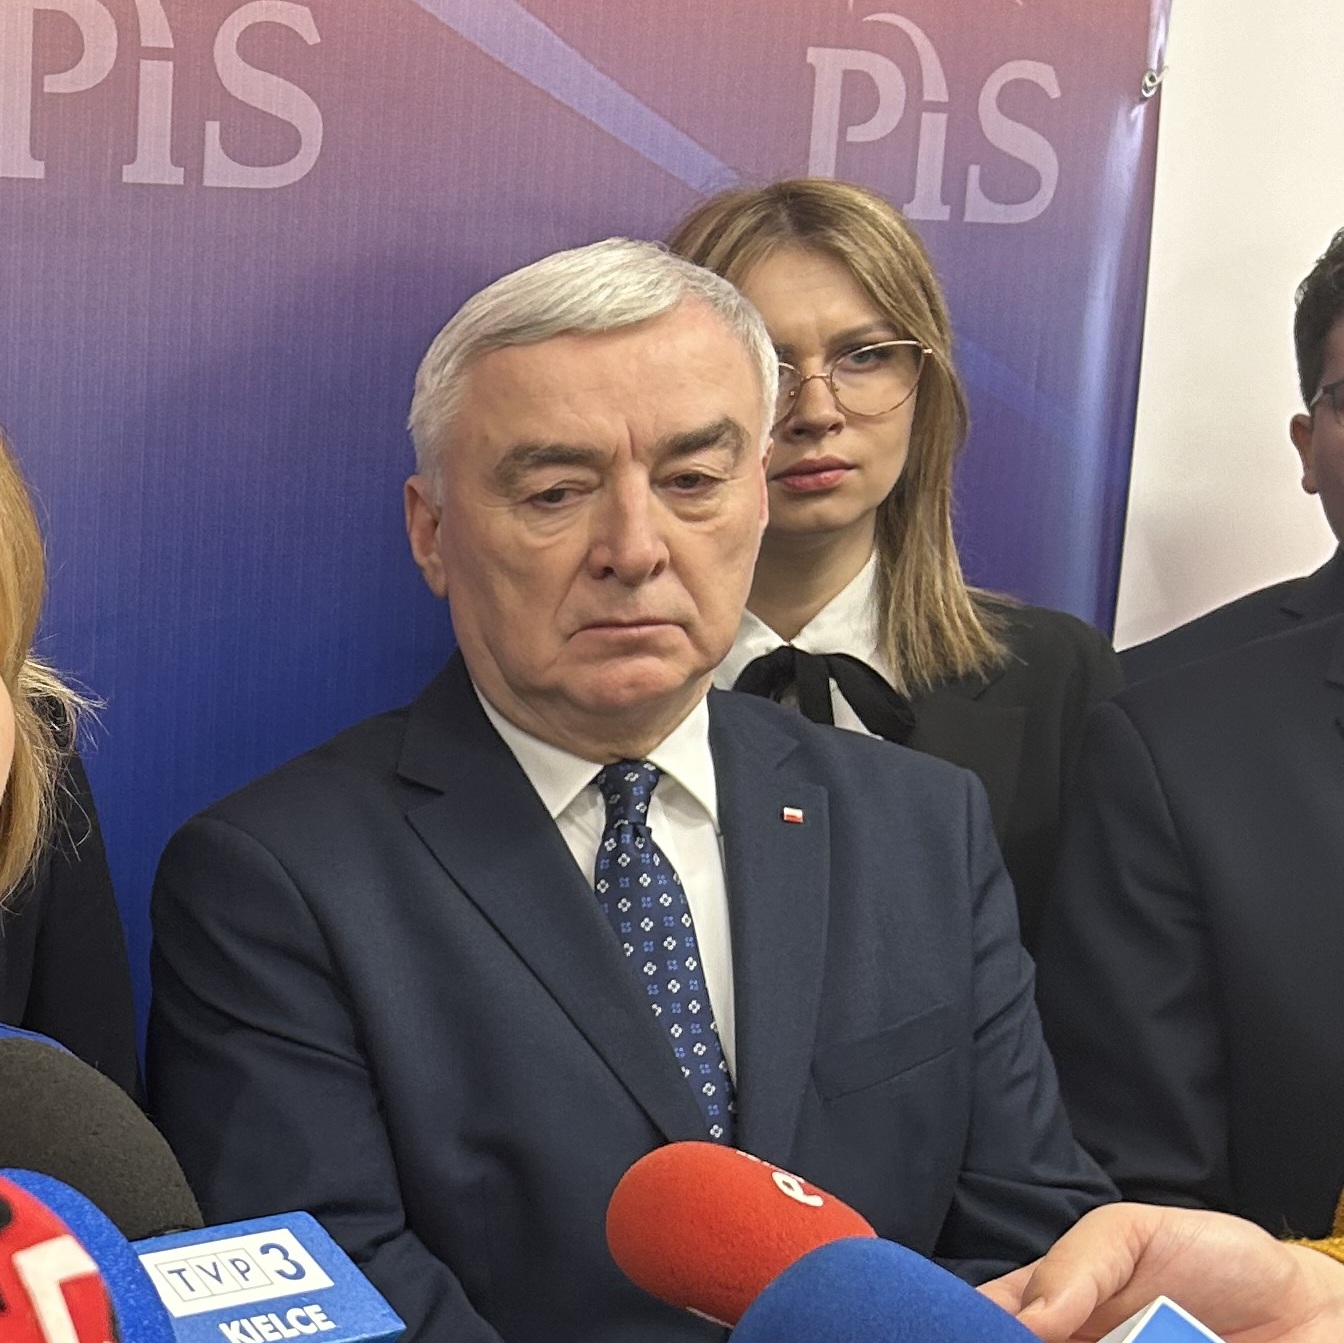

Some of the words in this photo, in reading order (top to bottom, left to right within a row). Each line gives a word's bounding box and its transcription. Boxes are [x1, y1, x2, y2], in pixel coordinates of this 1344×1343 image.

[806, 12, 1061, 224] PiS
[167, 1257, 251, 1292] TVP
[259, 1242, 306, 1281] 3
